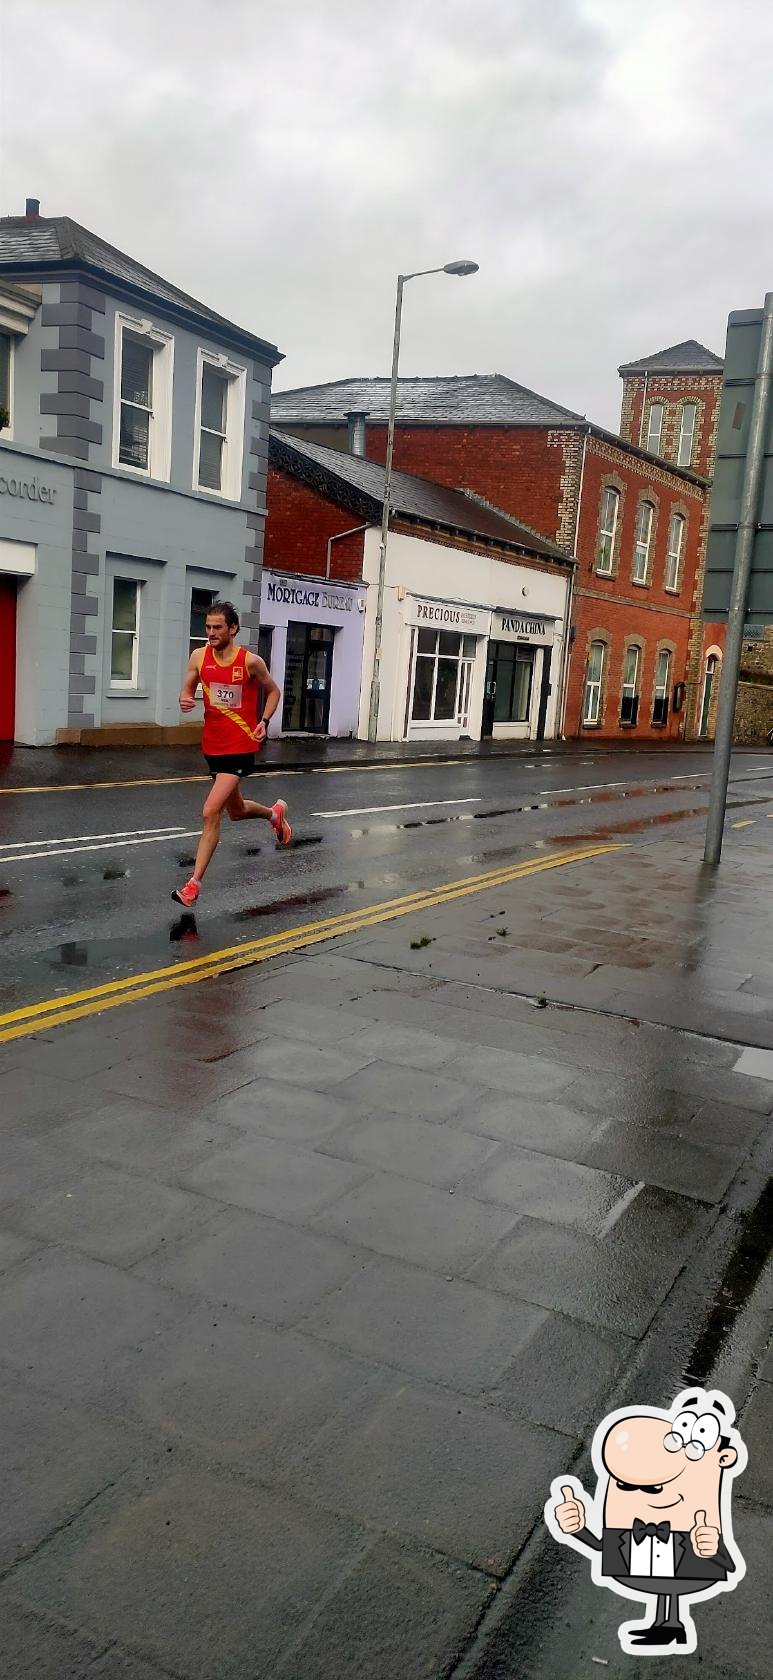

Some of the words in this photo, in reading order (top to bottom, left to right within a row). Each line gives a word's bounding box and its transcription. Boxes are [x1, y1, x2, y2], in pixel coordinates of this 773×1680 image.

[267, 583, 319, 607] MORTGAGE
[417, 604, 461, 624] PRECIOUS
[216, 689, 234, 699] 370
